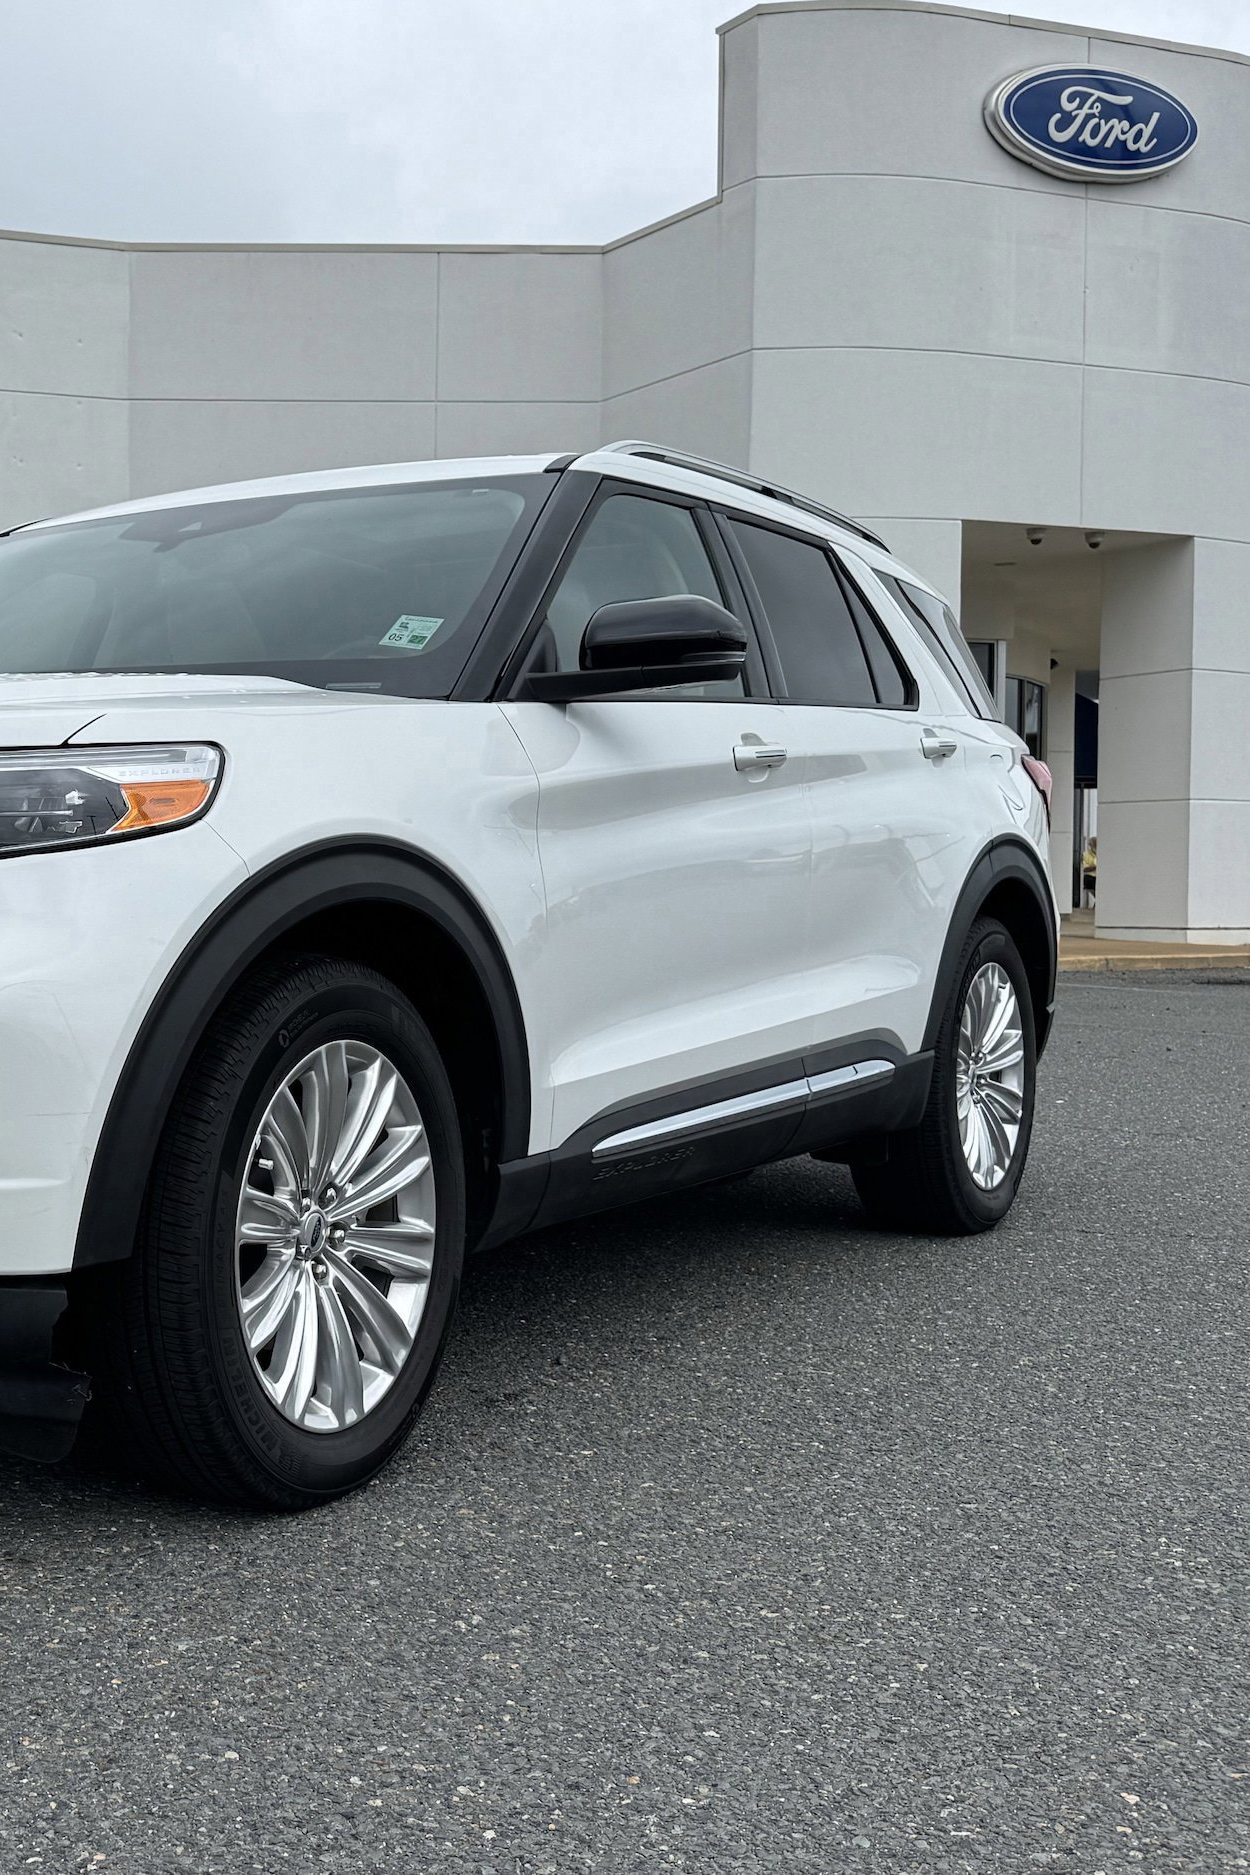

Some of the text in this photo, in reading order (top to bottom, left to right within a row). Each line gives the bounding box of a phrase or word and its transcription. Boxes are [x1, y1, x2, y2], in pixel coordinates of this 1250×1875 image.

[1047, 85, 1160, 154] Ford
[388, 633, 404, 642] 05
[118, 767, 201, 777] EXPLORER
[592, 1146, 695, 1181] EXPLORER
[220, 1335, 279, 1451] MICHELIN
